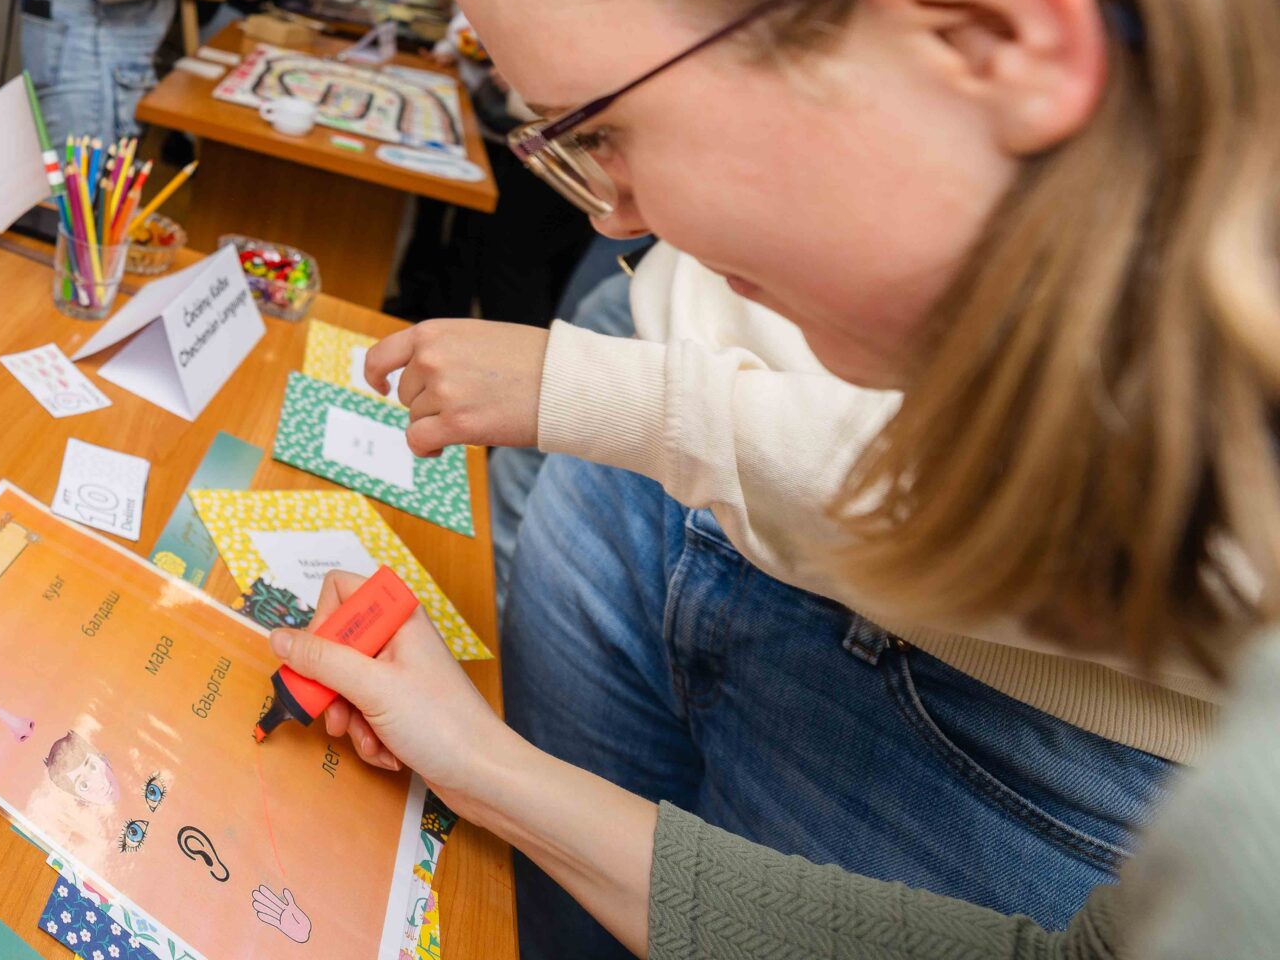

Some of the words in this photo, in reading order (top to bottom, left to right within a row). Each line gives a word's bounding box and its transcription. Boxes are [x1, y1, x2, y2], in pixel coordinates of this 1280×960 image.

[75, 483, 119, 527] 10
[81, 590, 120, 638] балдаш
[144, 635, 174, 676] Мара
[191, 656, 232, 719] баьргаш
